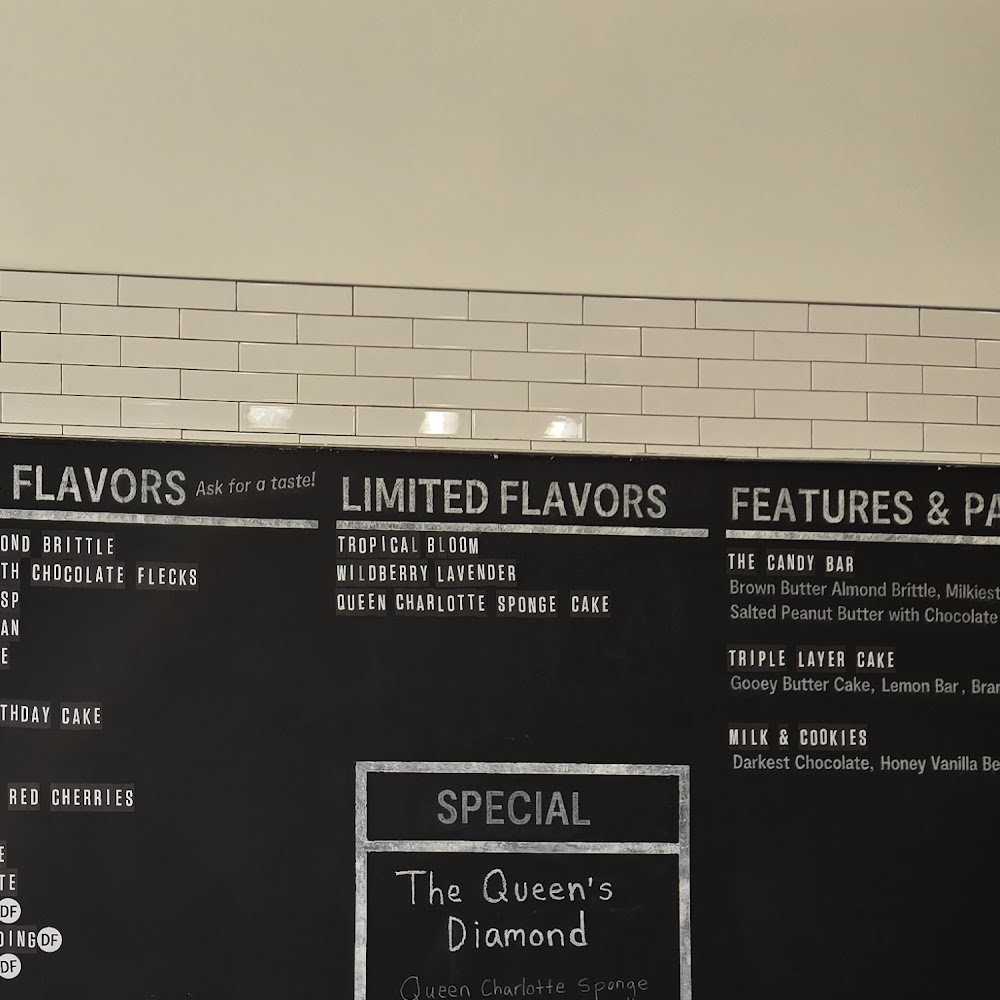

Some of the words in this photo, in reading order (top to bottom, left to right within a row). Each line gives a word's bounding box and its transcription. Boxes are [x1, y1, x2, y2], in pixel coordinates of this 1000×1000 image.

[13, 465, 185, 505] FLAVORS
[196, 480, 223, 496] Ask
[229, 478, 251, 493] for
[257, 480, 265, 491] a
[271, 472, 315, 490] taste!
[343, 477, 488, 514] LIMITED
[501, 481, 666, 518] FLAVORS
[732, 487, 912, 524] FEATURES
[927, 491, 949, 525] &
[44, 536, 113, 555] BRITTLE
[338, 536, 417, 553] TROPICAL
[428, 537, 478, 554] BLOOM
[728, 553, 754, 569] THE
[768, 554, 814, 571] CANDY
[826, 556, 853, 572] BAR
[33, 564, 123, 583] CHOCOLATE
[138, 567, 196, 585] FLECKS
[337, 565, 427, 581] WILDBERRY
[438, 564, 515, 582] LAVENDER
[730, 580, 775, 594] Brown
[781, 580, 827, 595] Butter
[832, 581, 886, 596] Almond
[892, 582, 940, 599] Brittle,
[946, 584, 1000, 600] Milkiest
[337, 594, 385, 610] QUEEN
[396, 594, 484, 612] CHARLOTTE
[498, 596, 556, 613] SPONGE
[572, 596, 608, 612] CAKE
[731, 604, 776, 619] Salted
[782, 605, 832, 620] Peanut
[838, 606, 884, 621] Butter
[889, 607, 919, 621] with
[925, 608, 998, 624] Chocolate
[729, 650, 785, 666] TRIPLE
[799, 651, 844, 667] LAYER
[858, 652, 894, 668] CAKE
[62, 708, 100, 724] CAKE
[729, 729, 768, 745] MILK
[779, 729, 788, 745] &
[800, 729, 866, 745] COOKIES
[10, 788, 38, 805] RED
[52, 789, 133, 806] CHERRIES
[438, 790, 590, 825] SPECIAL
[395, 871, 462, 905] The
[483, 869, 612, 903] Queen's
[0, 903, 18, 919] DF
[40, 932, 59, 948] DF
[448, 910, 587, 951] Diamond
[0, 959, 18, 974] DF
[481, 978, 566, 997] Charlotte
